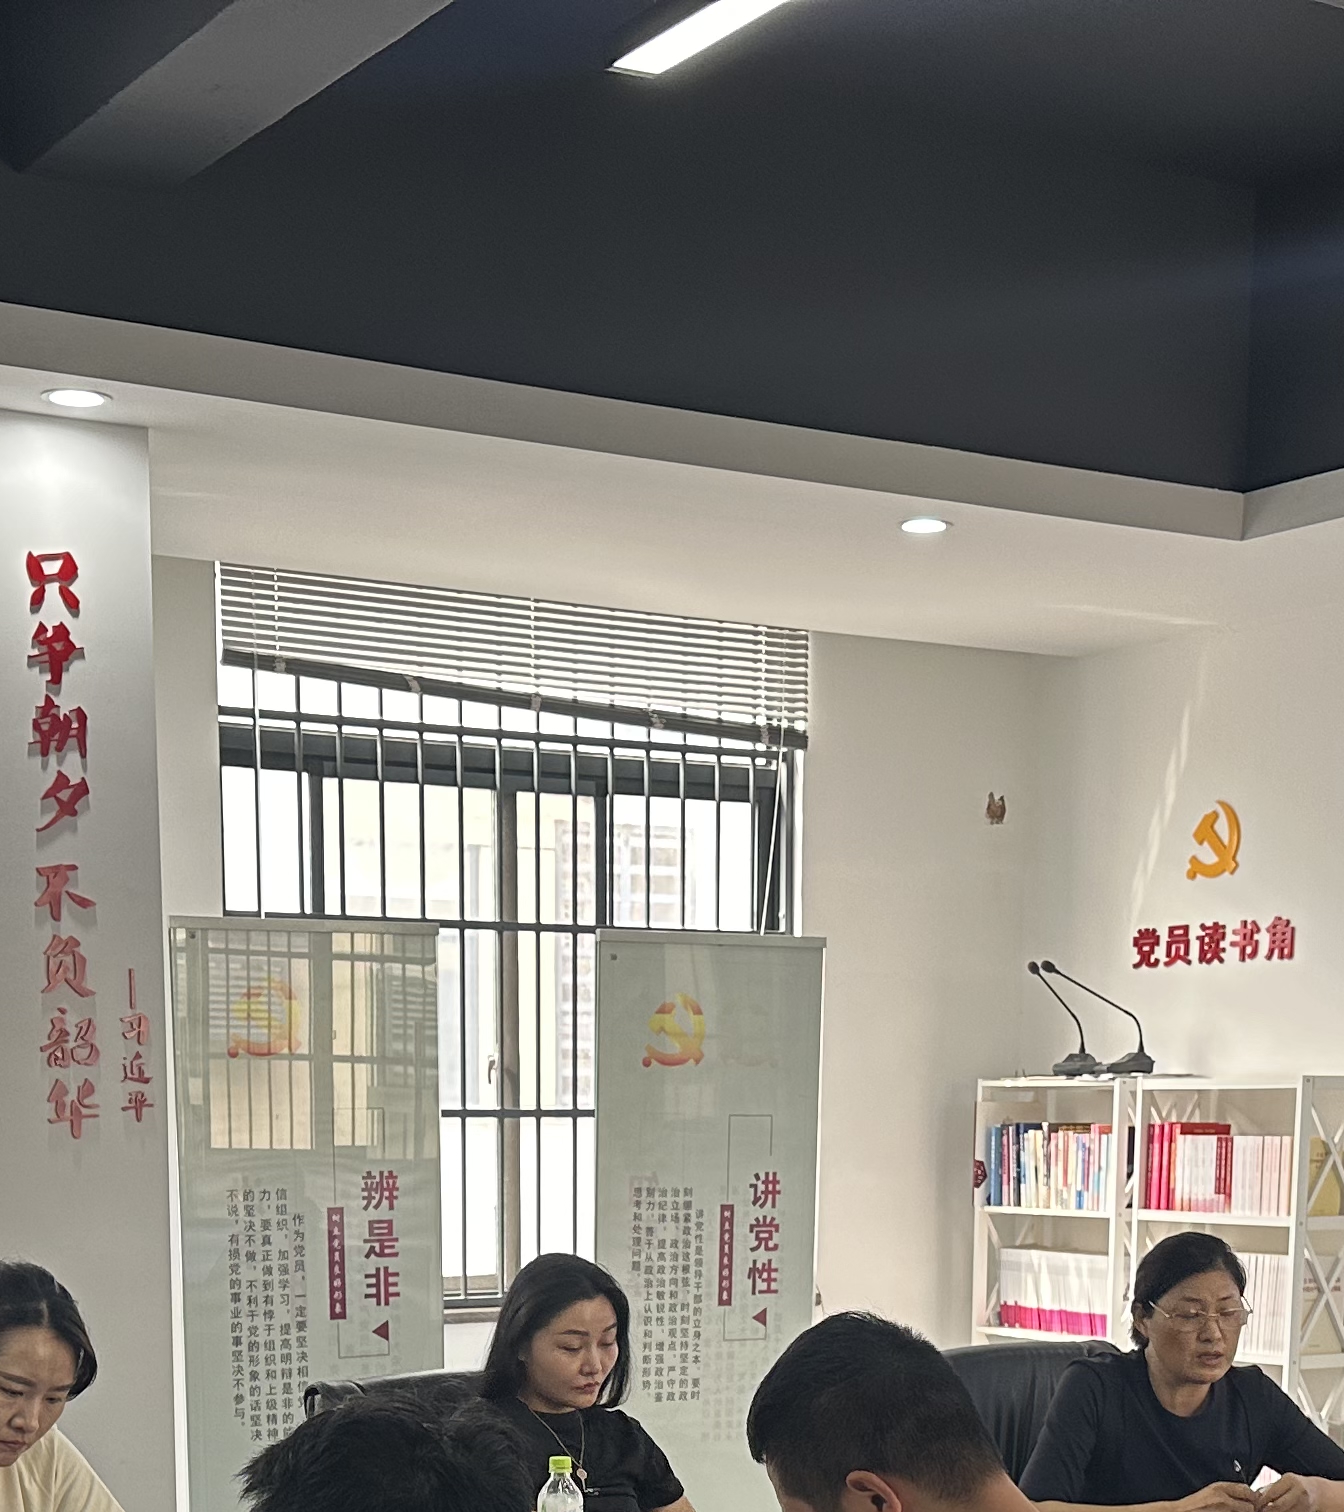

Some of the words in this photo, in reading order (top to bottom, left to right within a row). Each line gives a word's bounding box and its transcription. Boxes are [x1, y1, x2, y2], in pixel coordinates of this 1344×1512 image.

[26, 550, 99, 1139] 只争朝夕不负韶华
[1132, 916, 1295, 969] 党员读书角
[361, 1170, 400, 1307] 辨是非
[747, 1171, 781, 1296] 讲党性
